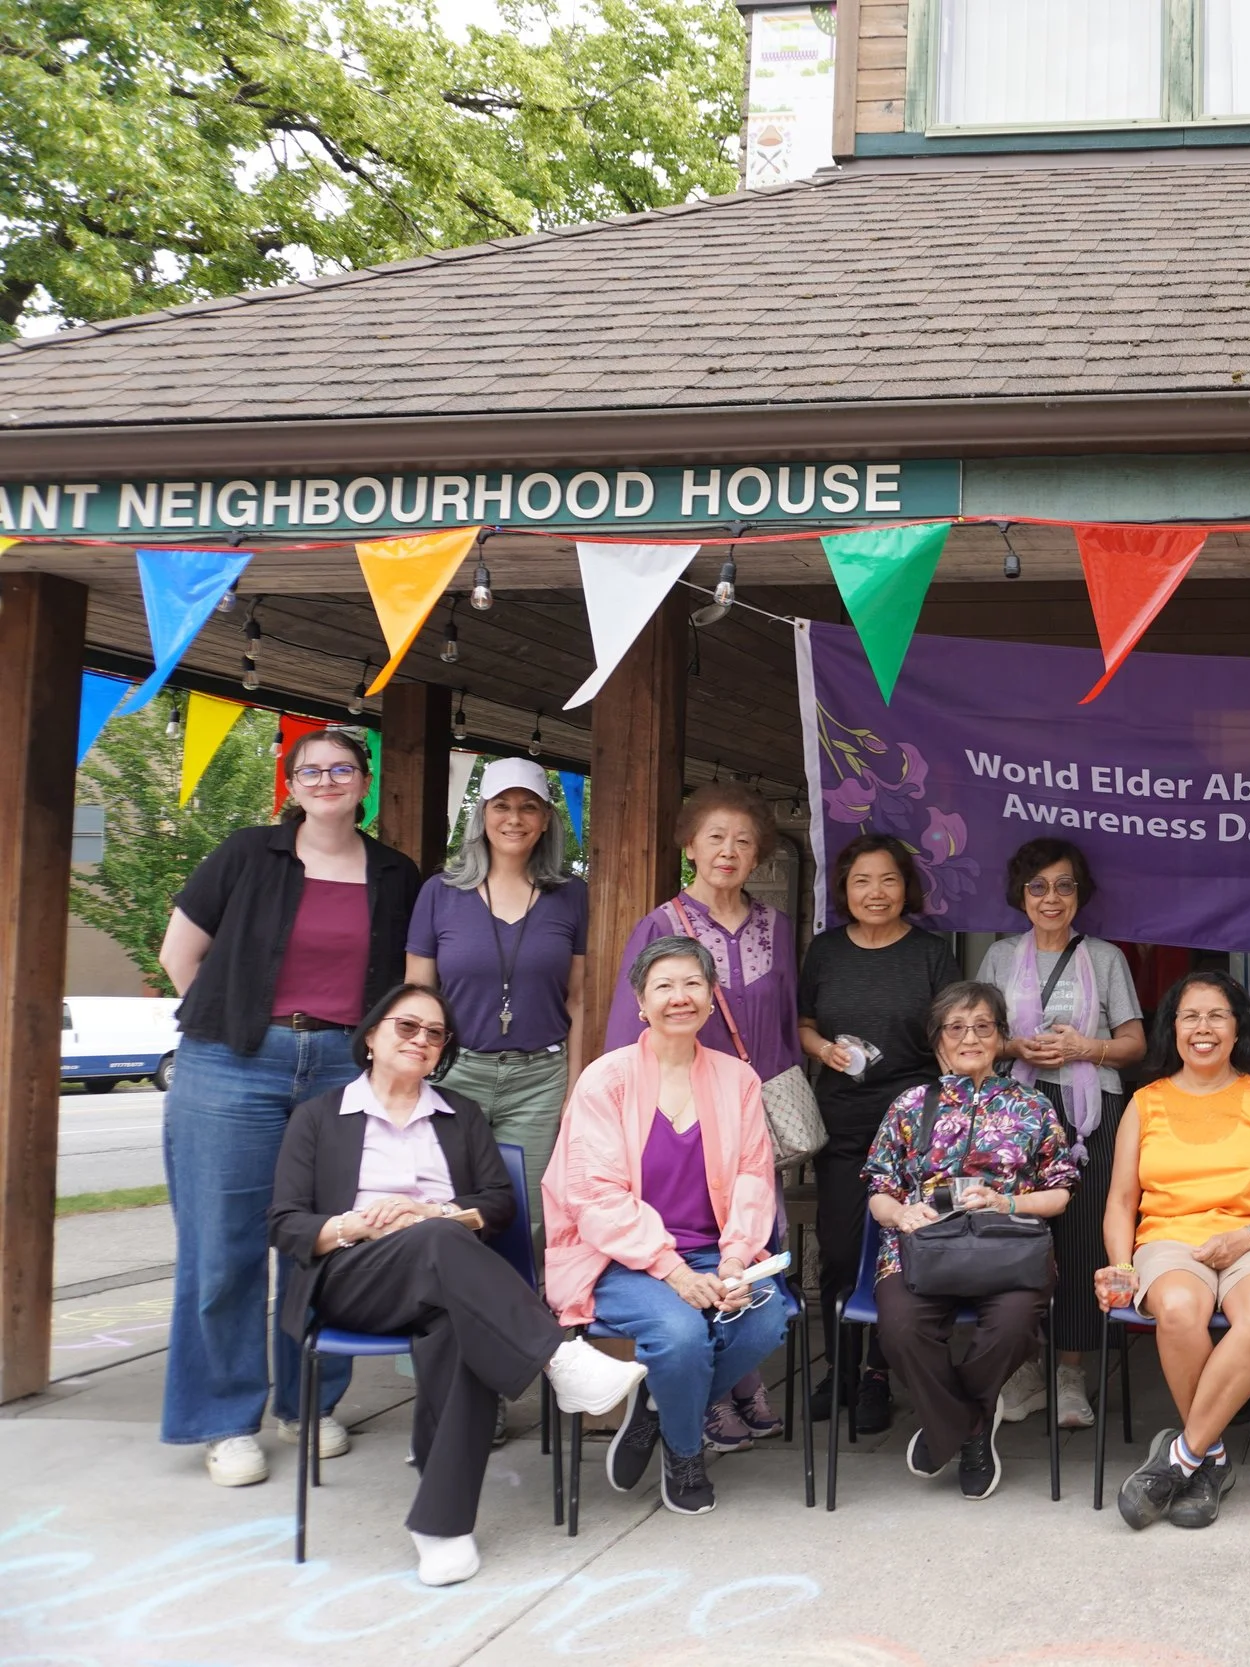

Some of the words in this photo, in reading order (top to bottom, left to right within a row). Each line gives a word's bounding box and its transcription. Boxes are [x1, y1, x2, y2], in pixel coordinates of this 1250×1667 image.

[117, 471, 655, 529] NEIGHBOURHOOD
[681, 464, 901, 516] HOUSE
[965, 749, 1079, 791] World
[1091, 766, 1193, 800] Elder
[1003, 793, 1207, 841] Awareness
